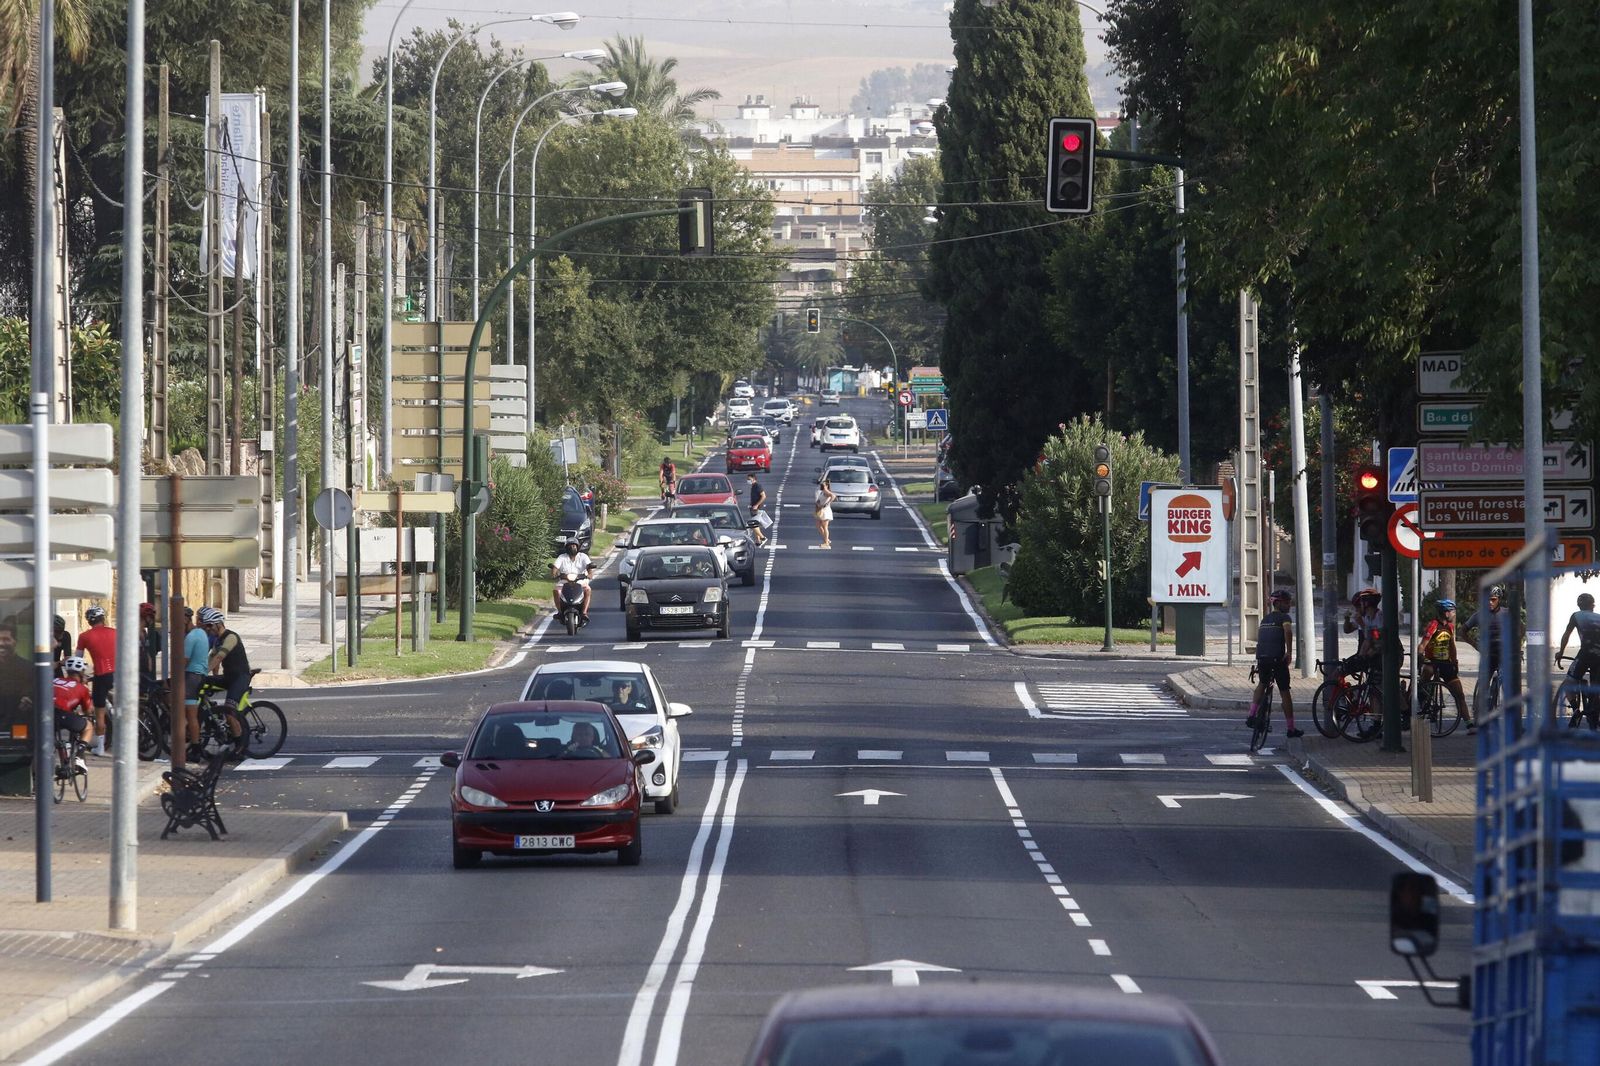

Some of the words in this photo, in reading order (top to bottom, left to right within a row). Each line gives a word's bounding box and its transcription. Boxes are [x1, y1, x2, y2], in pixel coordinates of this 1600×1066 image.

[1426, 450, 1492, 461] santuario
[1496, 449, 1513, 461] de
[1426, 462, 1466, 473] Santo
[1471, 462, 1523, 475] Doming
[1427, 501, 1474, 512] parque
[1479, 499, 1526, 509] foresta
[1168, 509, 1211, 519] BURGER
[1427, 511, 1451, 521] Los
[1457, 510, 1509, 521] Villares
[1168, 520, 1211, 534] KING
[1428, 548, 1473, 559] Campo
[1479, 547, 1495, 557] de
[1168, 584, 1173, 596] 1
[1177, 584, 1211, 596] MIN.
[521, 837, 548, 847] 2813
[551, 836, 573, 847] CWC
